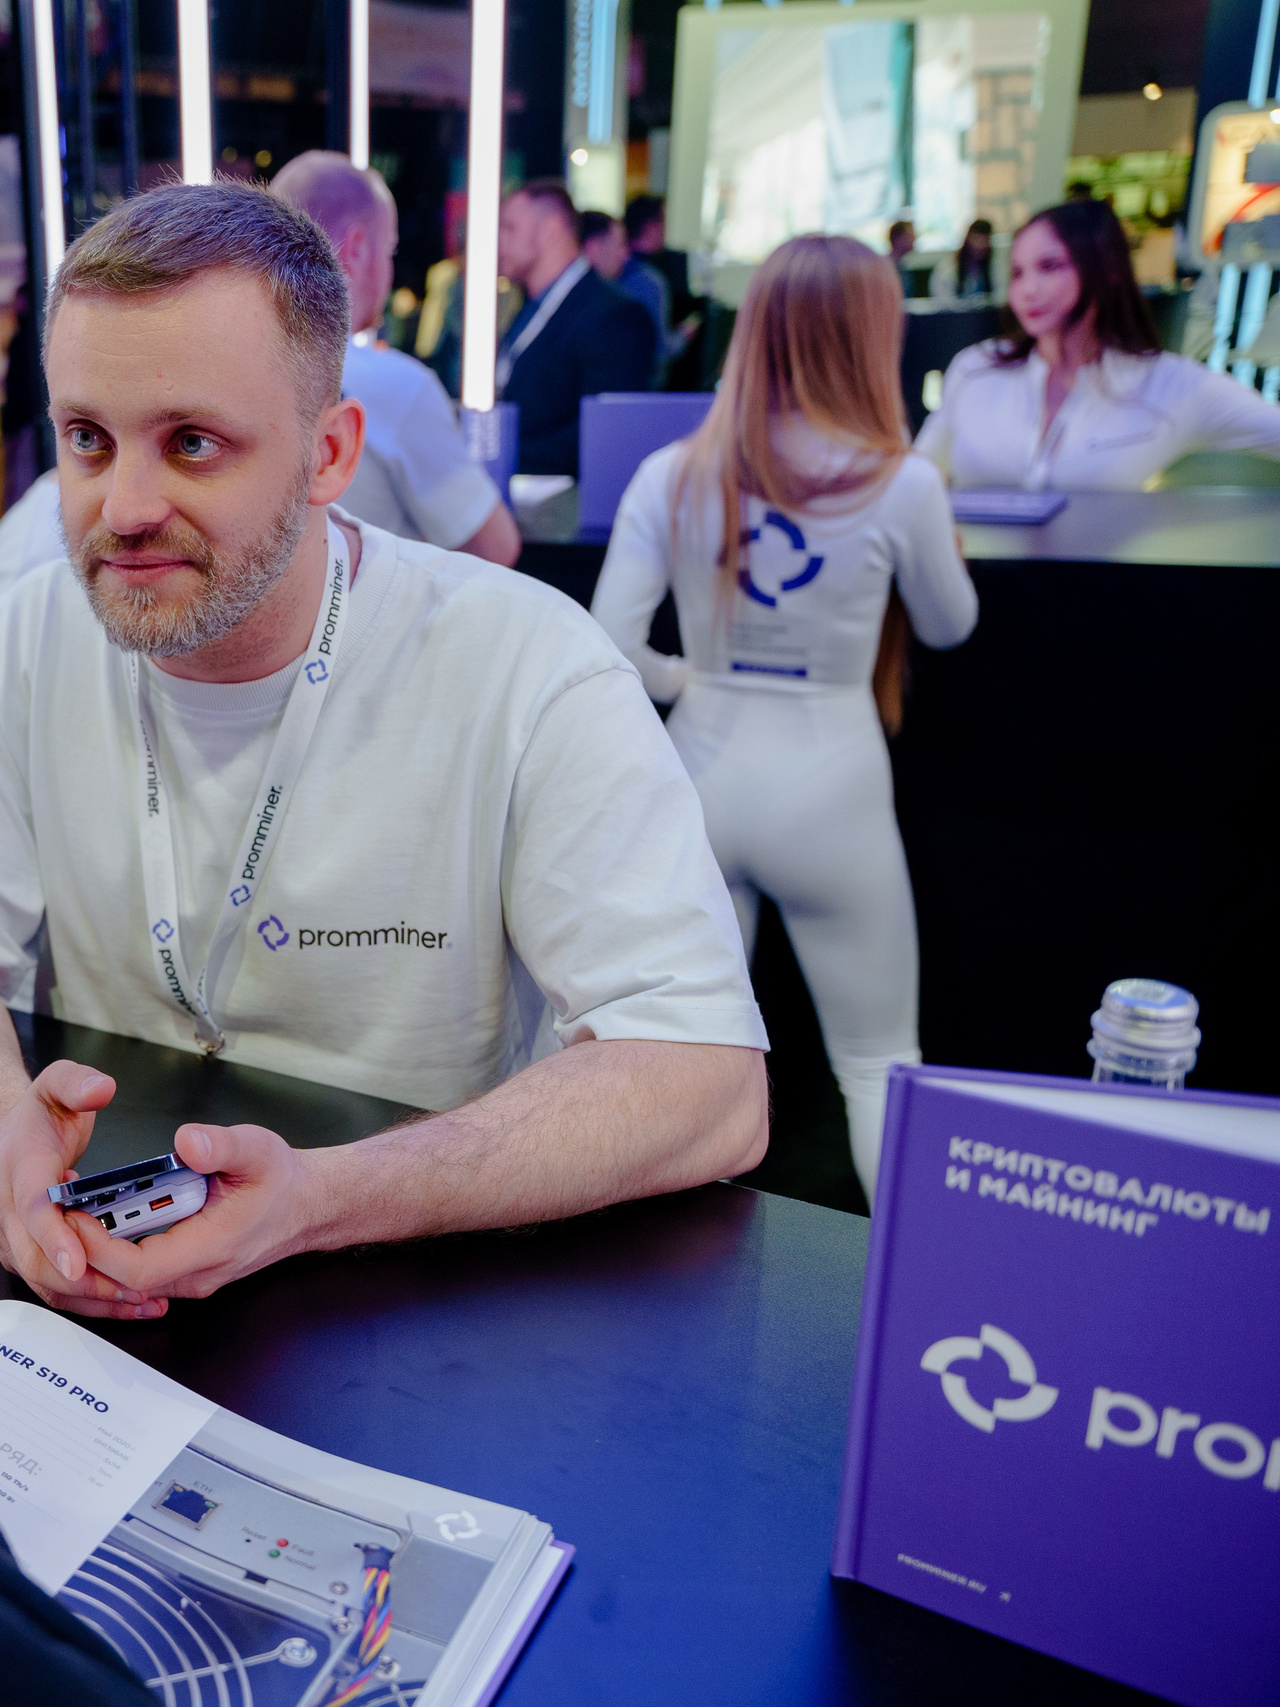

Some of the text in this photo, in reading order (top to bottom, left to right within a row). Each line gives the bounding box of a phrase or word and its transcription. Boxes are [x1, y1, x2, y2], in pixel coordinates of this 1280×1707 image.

[948, 1136, 1271, 1236] КРИПТОВАЛЮТЫ
[944, 1165, 1160, 1237] И МАЙНИНГ
[36, 1366, 68, 1388] S19
[68, 1385, 109, 1413] PRO
[12, 1478, 29, 1492] Th/s
[193, 1480, 213, 1493] ETH
[241, 1526, 267, 1540] Reset
[291, 1543, 315, 1557] Fault
[283, 1554, 318, 1571] Normal
